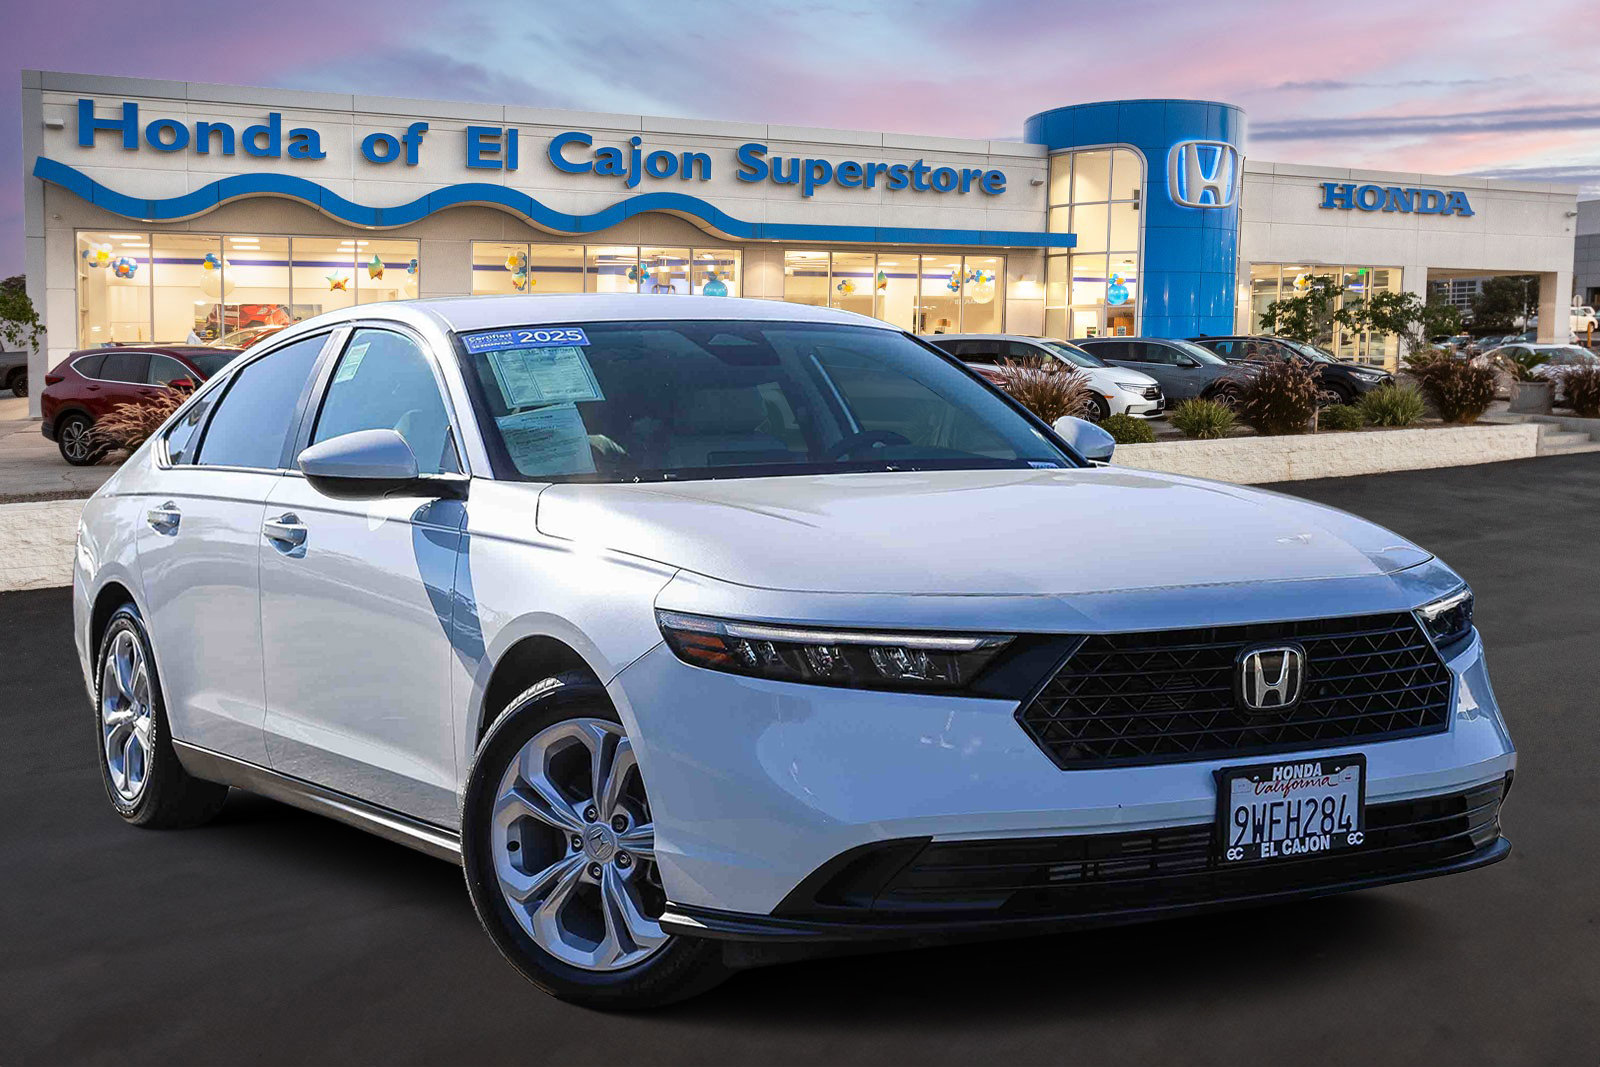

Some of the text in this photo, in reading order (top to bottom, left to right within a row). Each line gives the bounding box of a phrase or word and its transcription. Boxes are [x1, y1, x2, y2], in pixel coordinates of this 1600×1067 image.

[78, 98, 1007, 199] Honda of El Cajon Superstore
[1319, 182, 1476, 216] HONDA
[468, 332, 512, 342] Certified
[517, 330, 583, 343] 2025
[1273, 762, 1322, 781] HONDA
[1254, 776, 1338, 798] California
[1234, 794, 1353, 846] 9WFH284
[1261, 834, 1331, 858] EL CAJON
